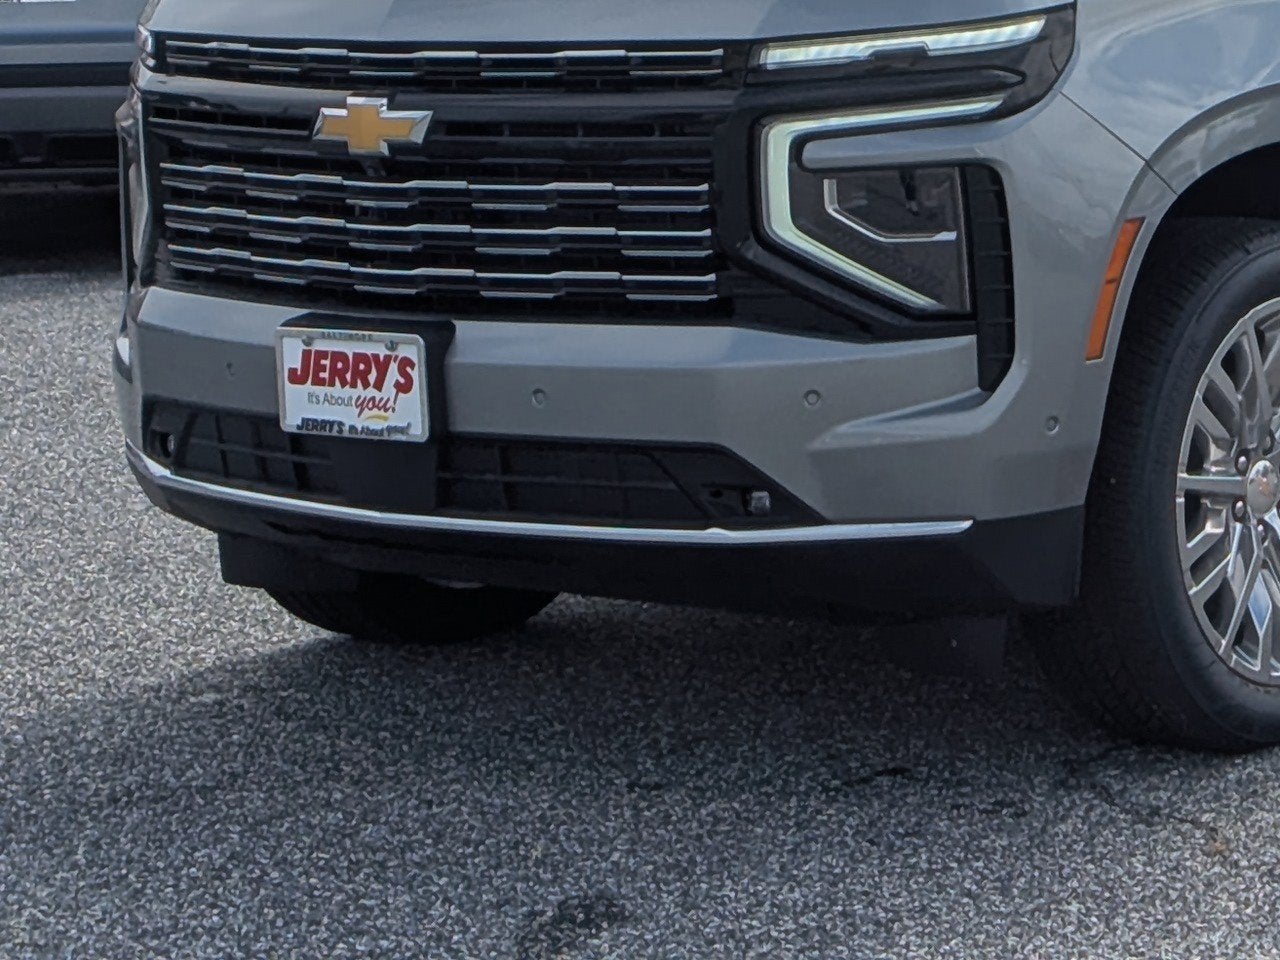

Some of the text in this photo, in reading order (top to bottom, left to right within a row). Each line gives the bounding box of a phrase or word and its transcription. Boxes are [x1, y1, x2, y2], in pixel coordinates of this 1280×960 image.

[287, 348, 417, 395] JERRY'S
[307, 389, 399, 418] It's About you!
